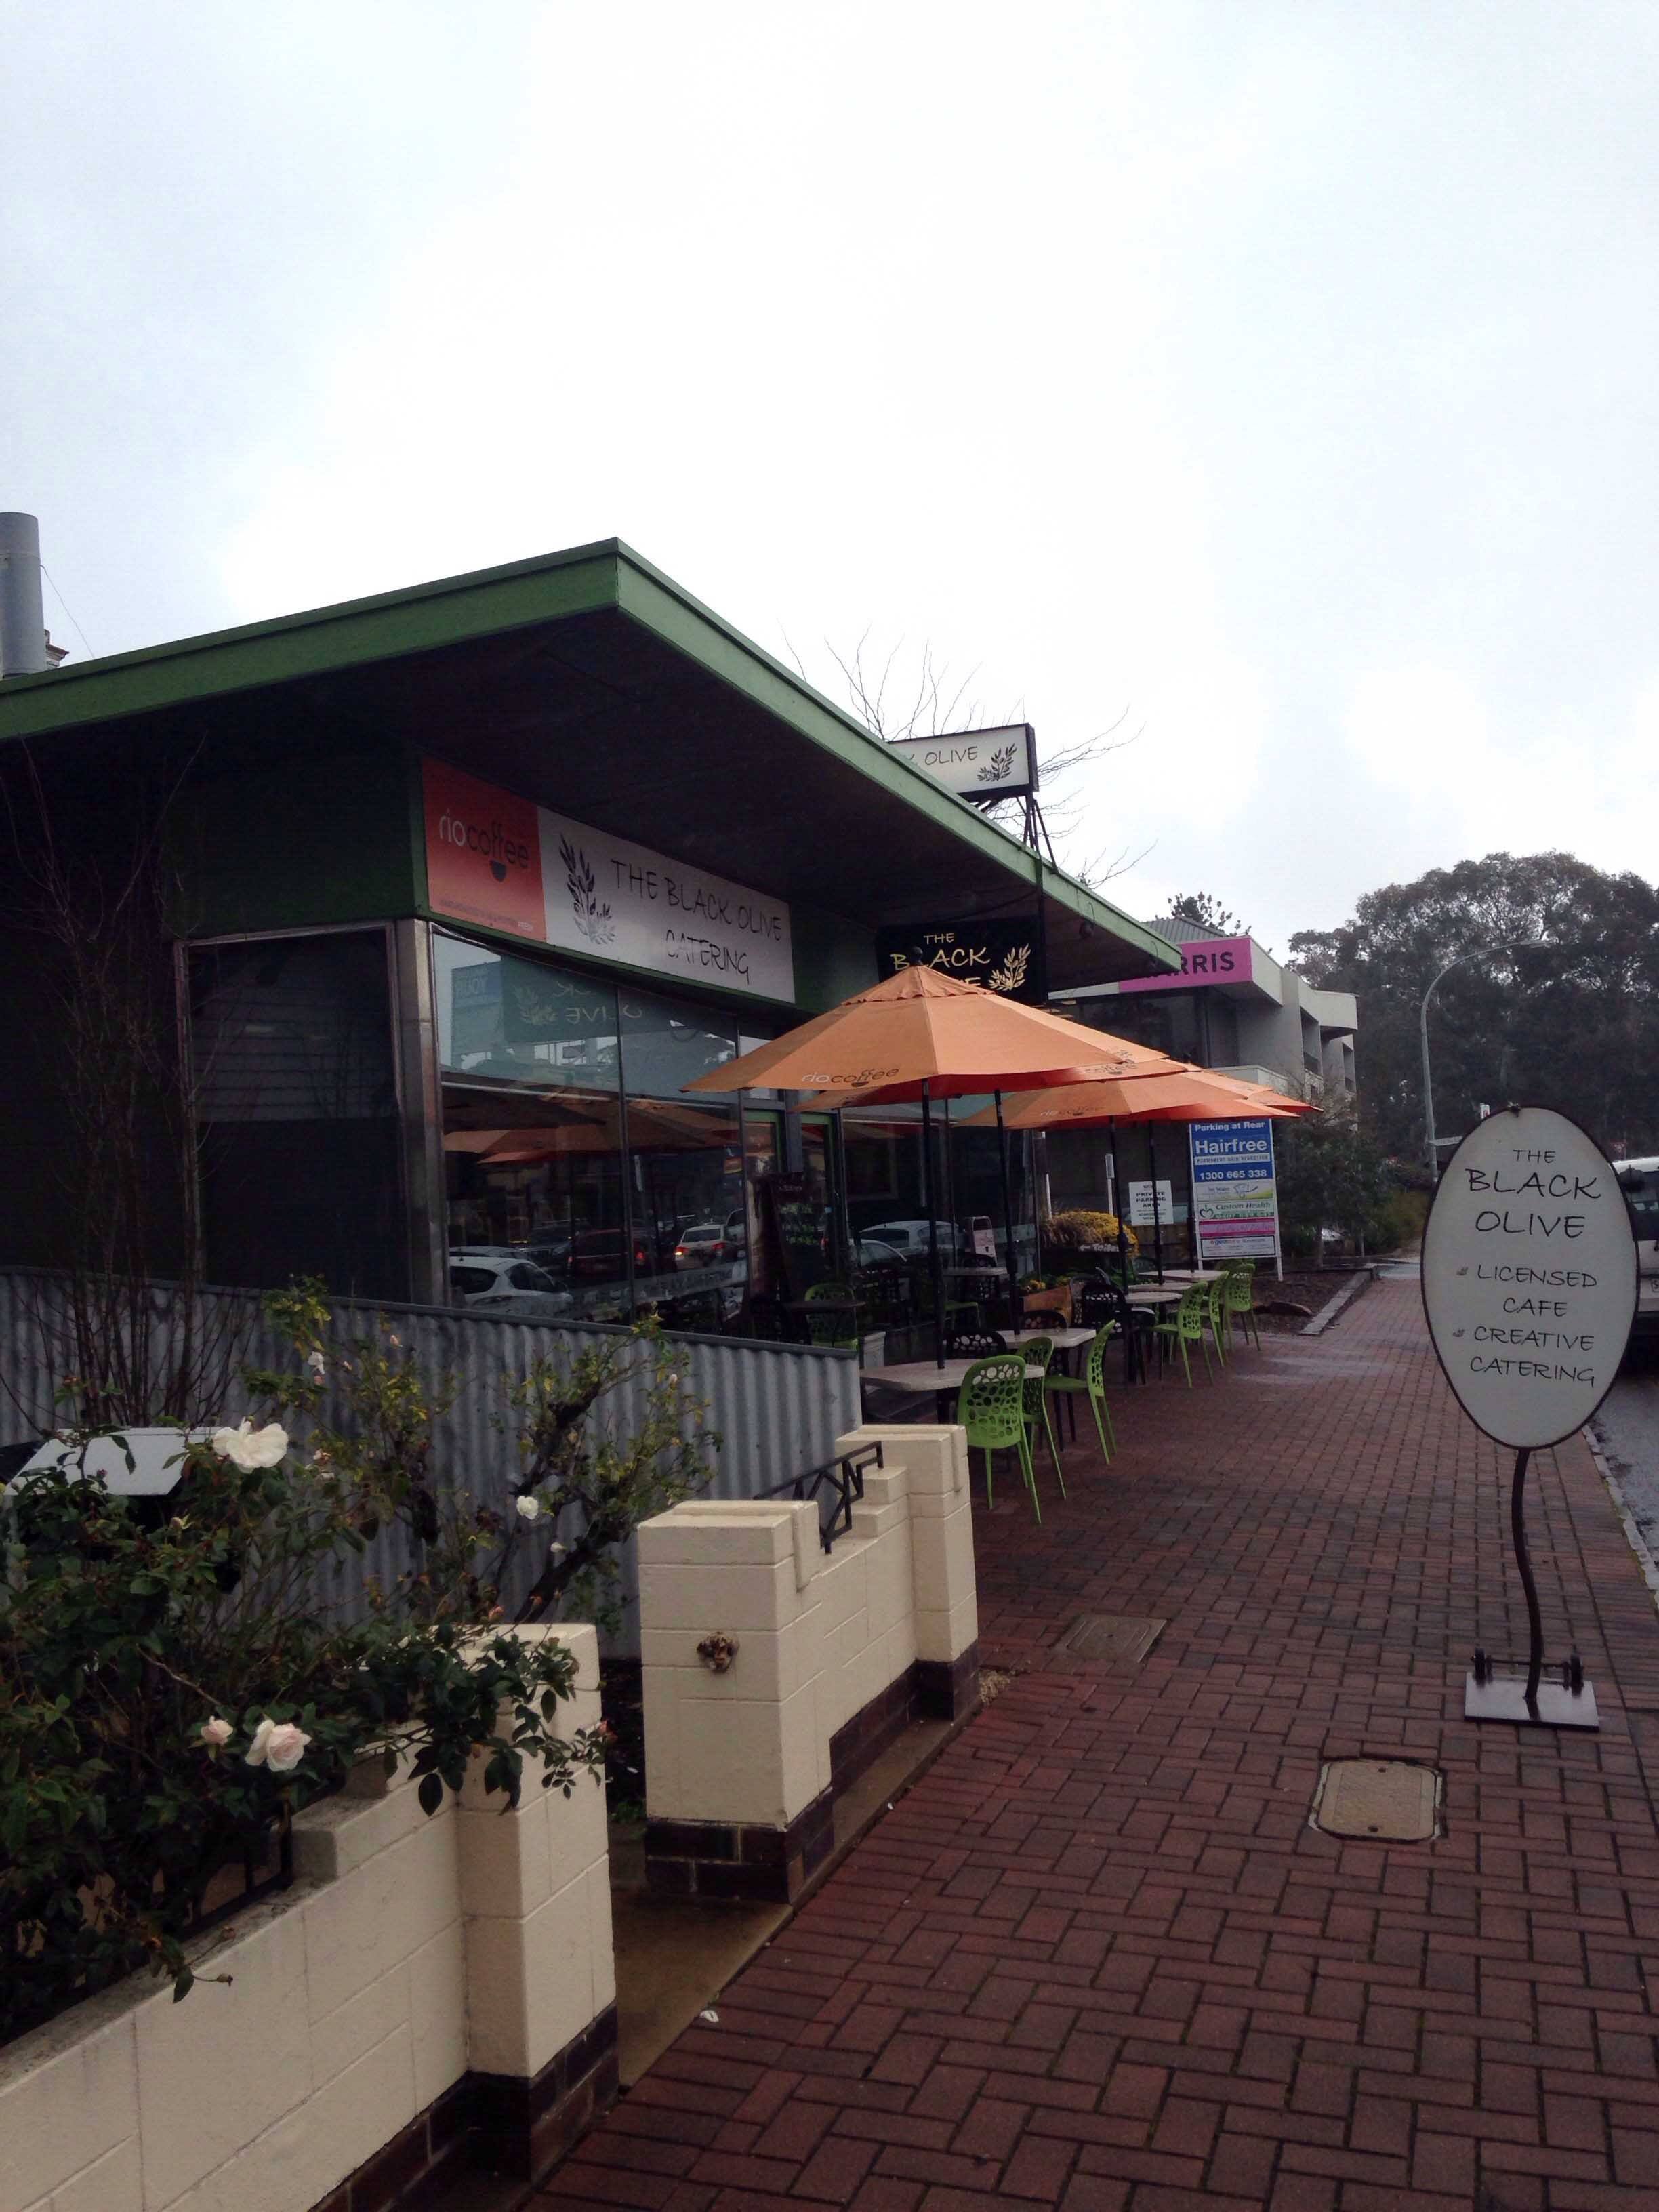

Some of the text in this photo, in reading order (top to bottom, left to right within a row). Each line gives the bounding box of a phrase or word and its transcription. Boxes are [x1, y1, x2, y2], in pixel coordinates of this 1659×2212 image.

[924, 746, 978, 766] OLIVE
[611, 858, 781, 941] THE BLACK OLIVE
[924, 933, 955, 945] THE
[666, 929, 750, 985] CATERING
[890, 947, 991, 970] BACK
[1164, 951, 1235, 976] RRIS
[1195, 1124, 1229, 1132] Parking
[1195, 1139, 1267, 1154] Hairfree
[1513, 1149, 1556, 1164] THE
[1200, 1172, 1224, 1180] 1300
[1248, 1170, 1267, 1178] 338
[1465, 1168, 1602, 1200] BLACK
[1475, 1211, 1585, 1238] OLIVE
[1477, 1265, 1597, 1288] LICENSED
[1502, 1297, 1568, 1317] CAFE
[1473, 1326, 1595, 1351] CREATIVE
[1470, 1357, 1595, 1387] CATERING
